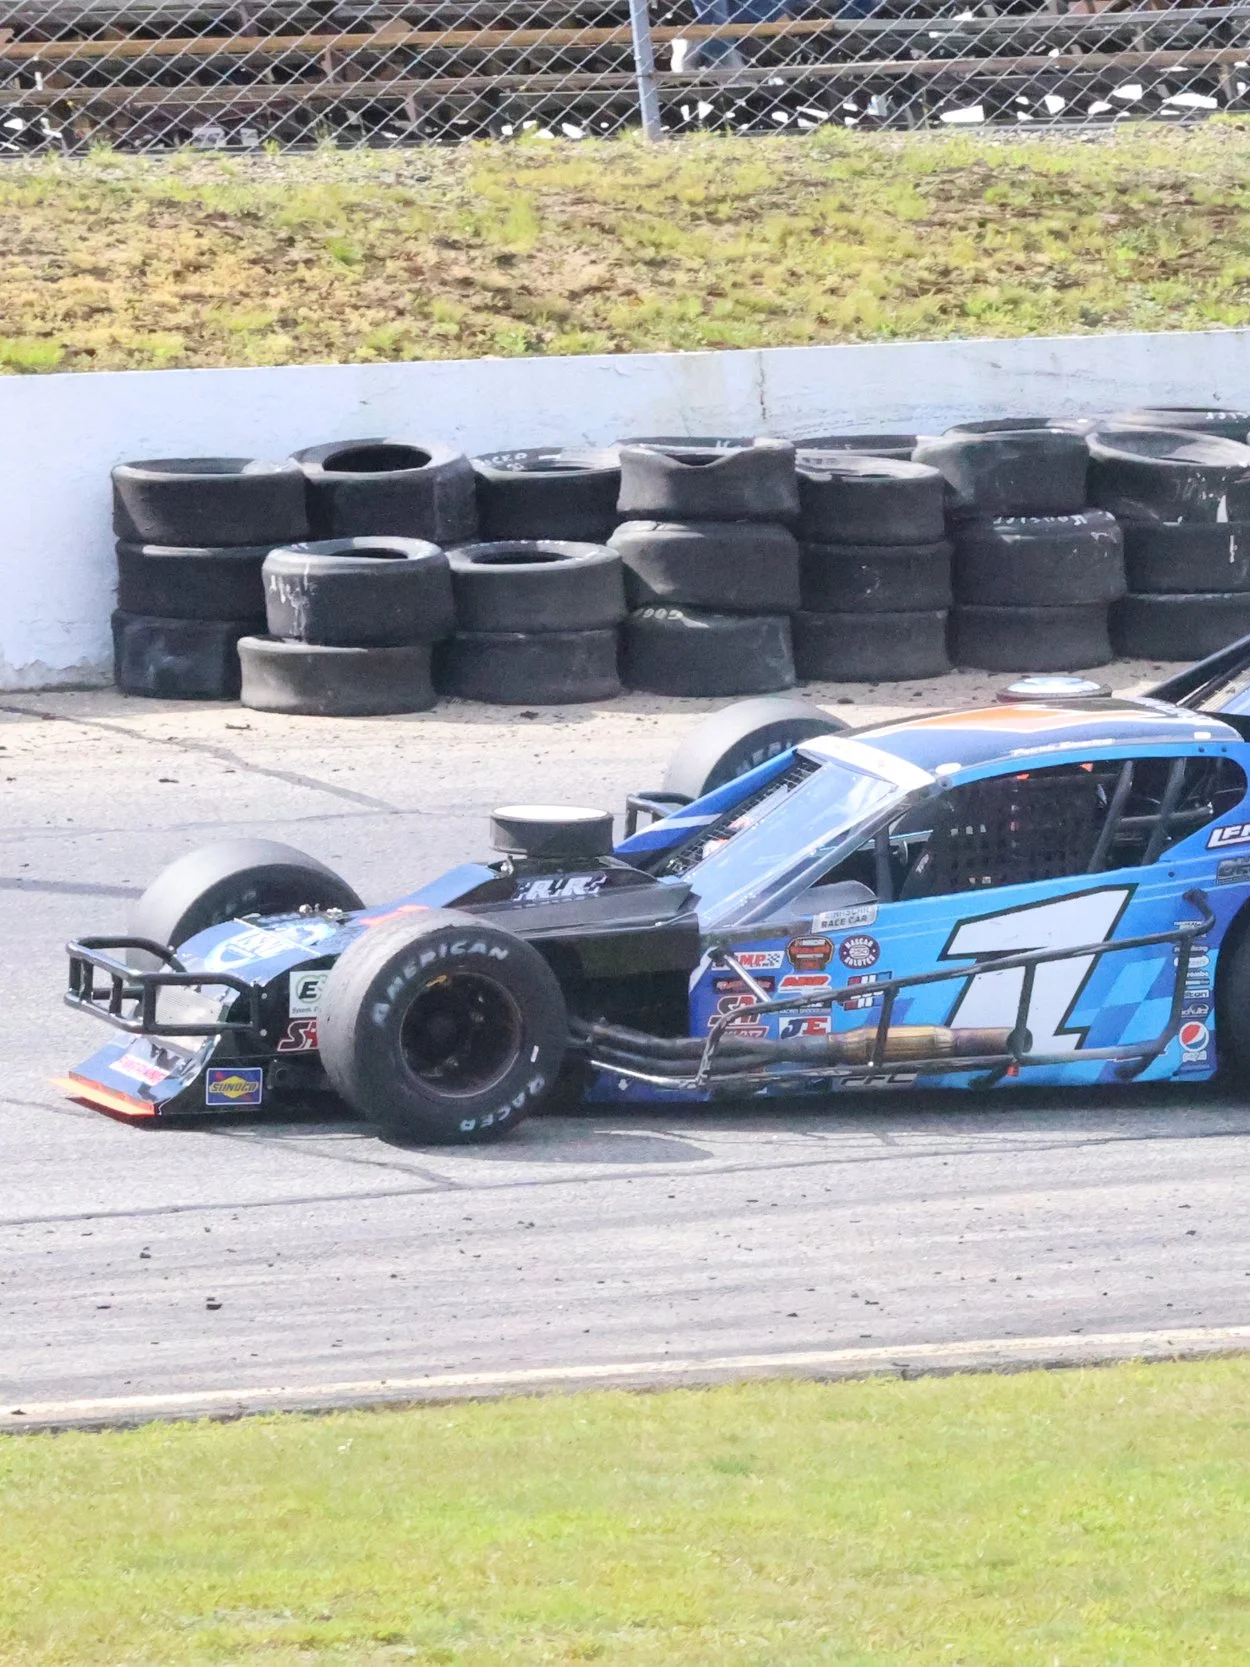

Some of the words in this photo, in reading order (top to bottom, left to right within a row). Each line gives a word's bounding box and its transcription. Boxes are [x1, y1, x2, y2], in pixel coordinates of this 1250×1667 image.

[821, 917, 846, 929] RACE
[848, 914, 868, 925] CAR
[844, 937, 874, 950] NASCAR
[372, 940, 509, 1026] AMERICAN
[211, 1082, 258, 1093] SUNOCO
[460, 1075, 546, 1131] RACER
